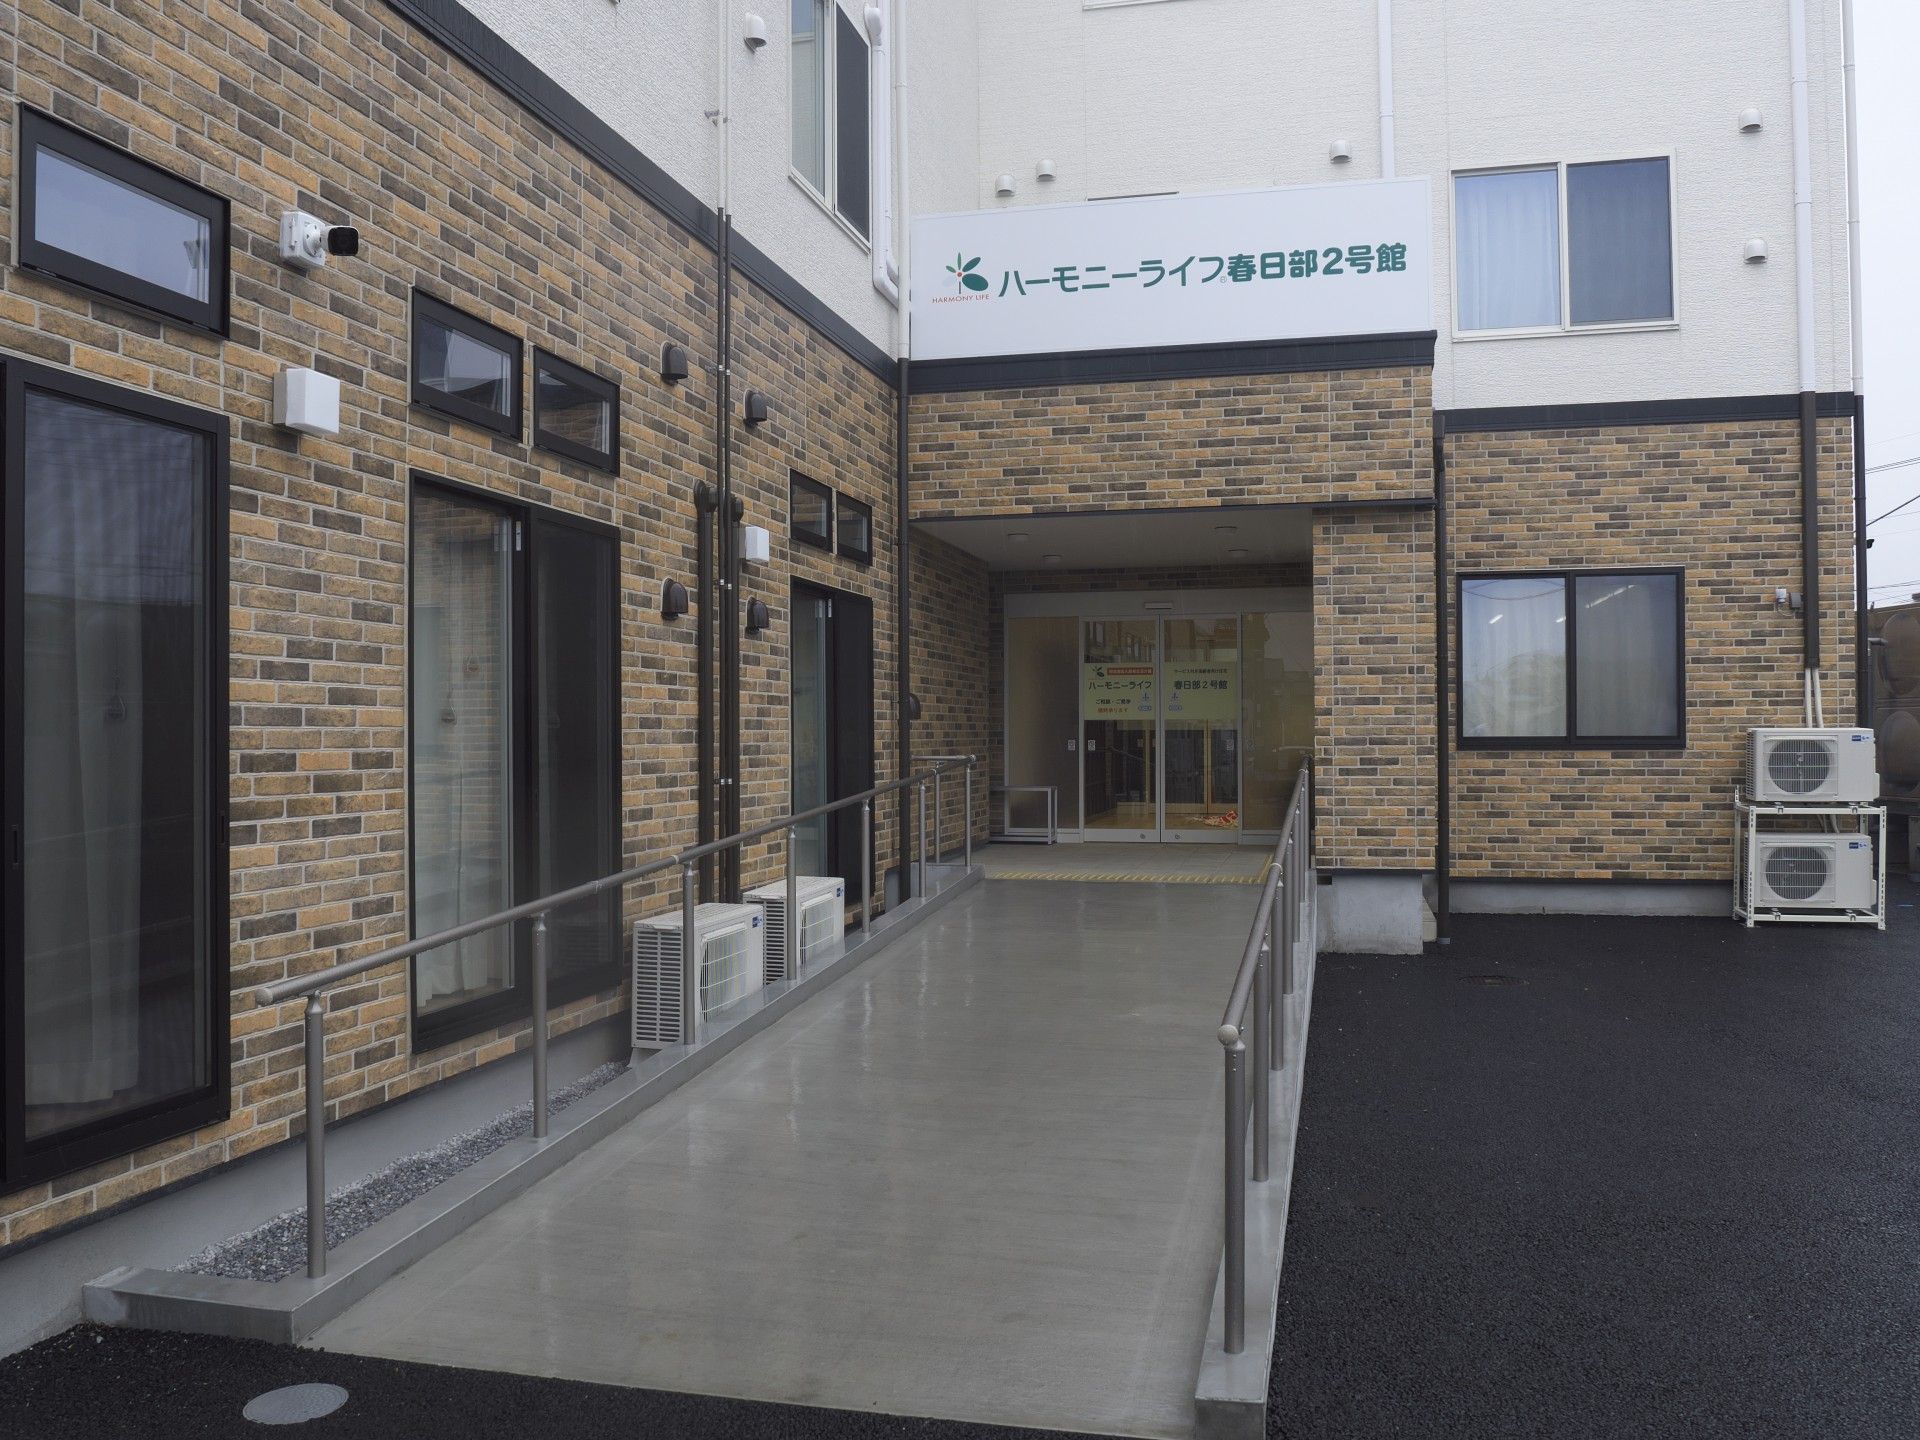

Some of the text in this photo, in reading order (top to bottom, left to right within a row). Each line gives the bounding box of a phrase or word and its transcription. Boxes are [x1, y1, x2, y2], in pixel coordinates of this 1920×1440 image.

[932, 295, 973, 304] HARMONY
[1088, 681, 1152, 690] ハーモニーライフ
